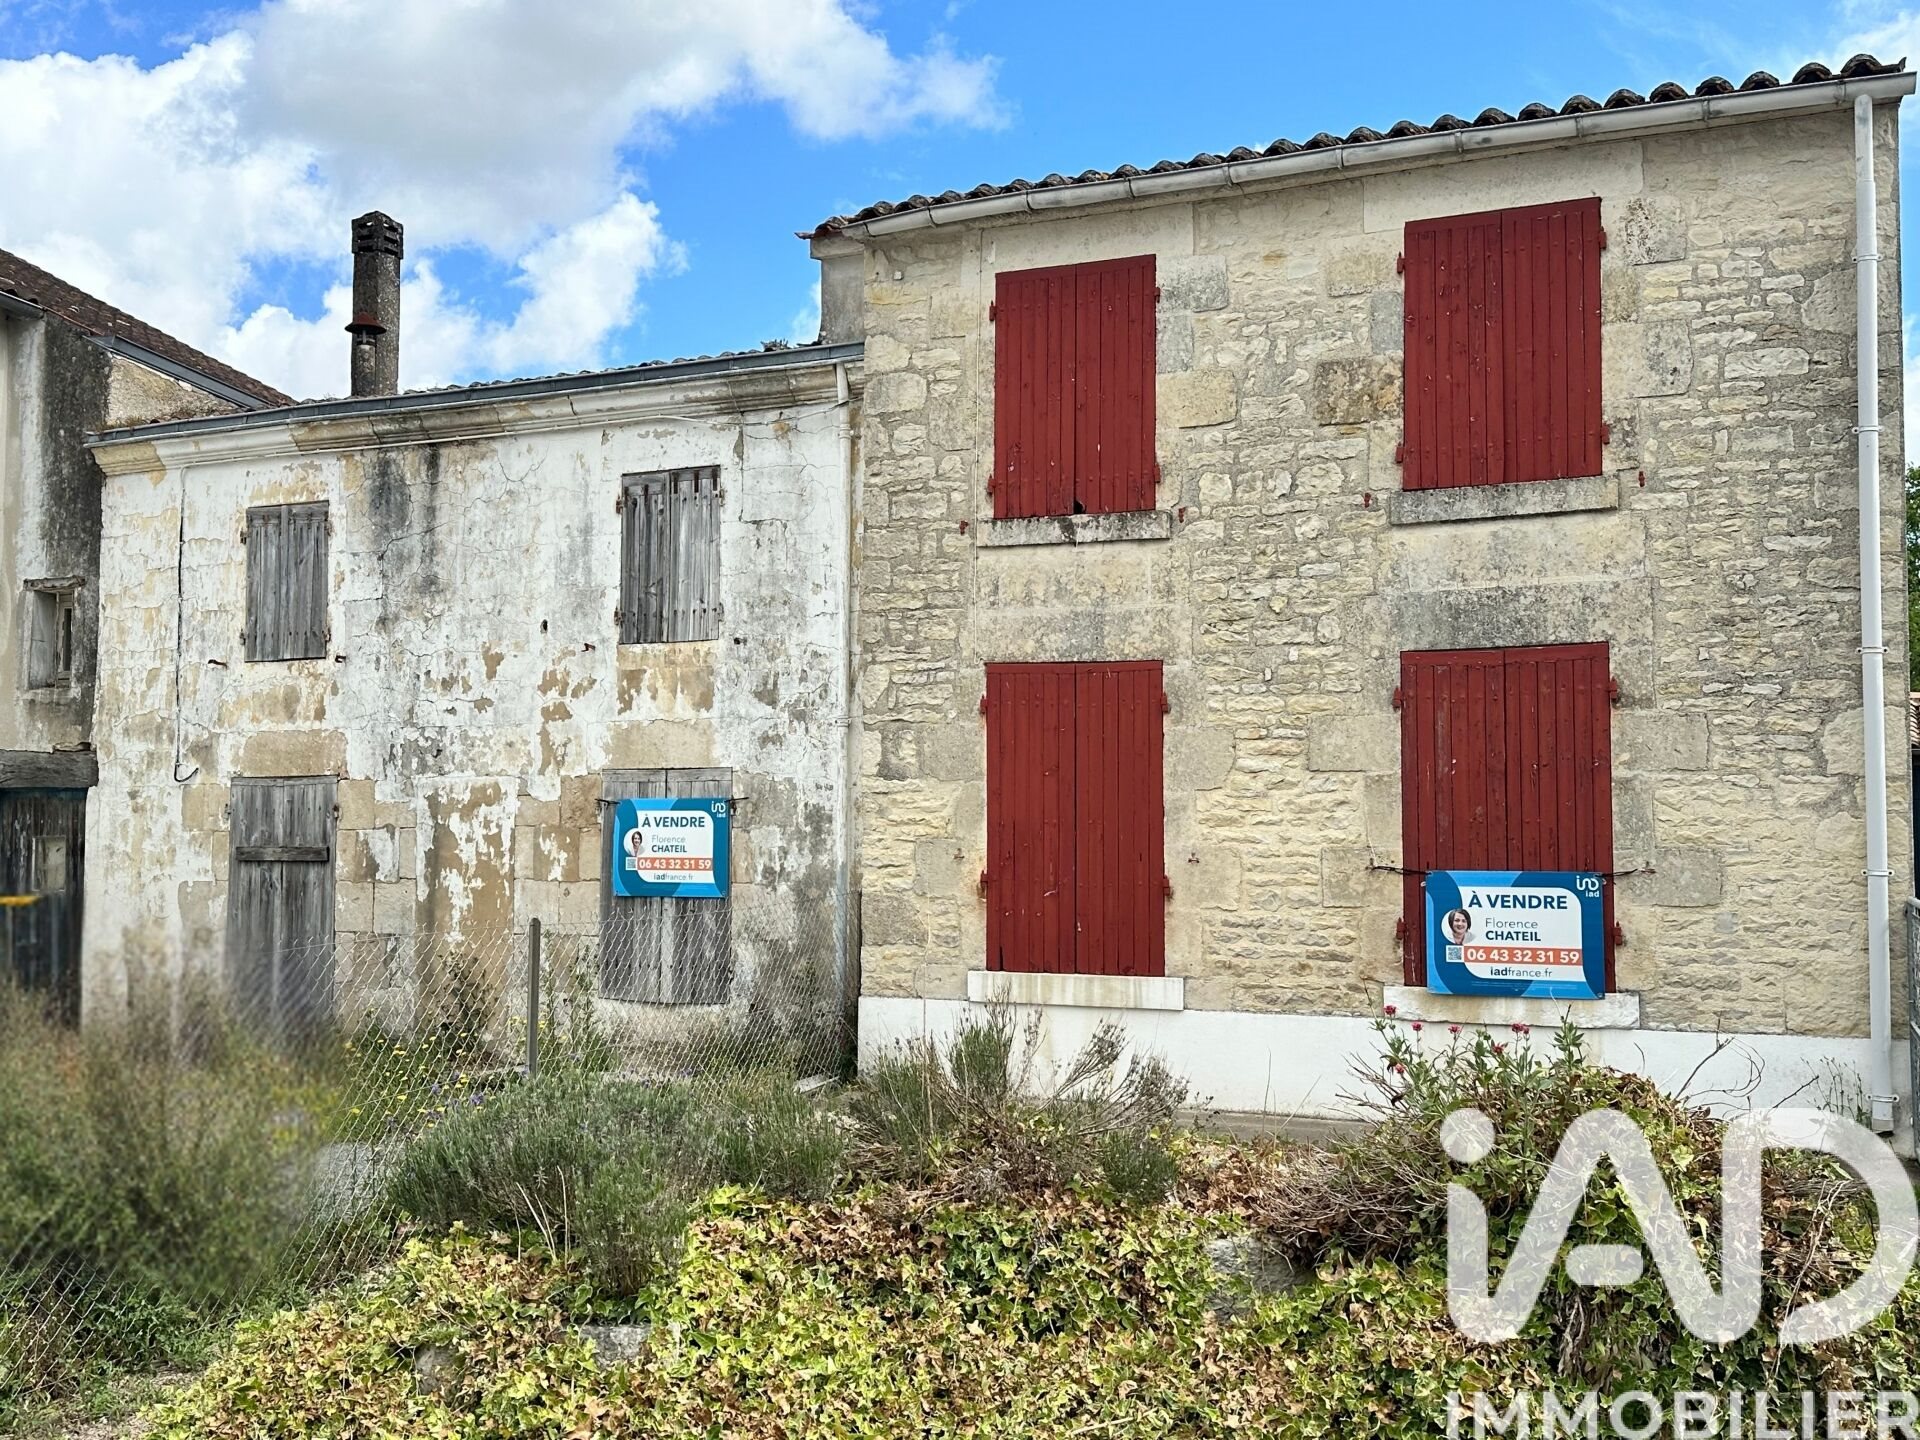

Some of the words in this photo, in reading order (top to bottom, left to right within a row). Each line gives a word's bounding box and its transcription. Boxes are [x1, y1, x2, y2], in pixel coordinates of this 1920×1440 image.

[641, 813, 651, 828] À
[653, 816, 706, 828] VENDRE
[651, 834, 686, 844] Florence
[651, 844, 688, 853] CHATEIL
[639, 859, 652, 870] 06
[653, 859, 666, 870] 43
[668, 859, 682, 870] 32
[684, 859, 696, 870] 31
[698, 859, 712, 870] 59
[653, 873, 694, 881] iadfrance.fr
[1468, 890, 1483, 908] À
[1486, 894, 1568, 910] VENDRE
[1585, 890, 1600, 898] iad
[1485, 917, 1538, 929] Florence
[1485, 930, 1541, 942] CHATEIL
[1466, 948, 1486, 961] 06
[1489, 949, 1509, 962] 43
[1513, 949, 1532, 962] 32
[1536, 950, 1555, 963] 31
[1559, 951, 1579, 964] 59
[1490, 966, 1552, 978] iadfrance.fr
